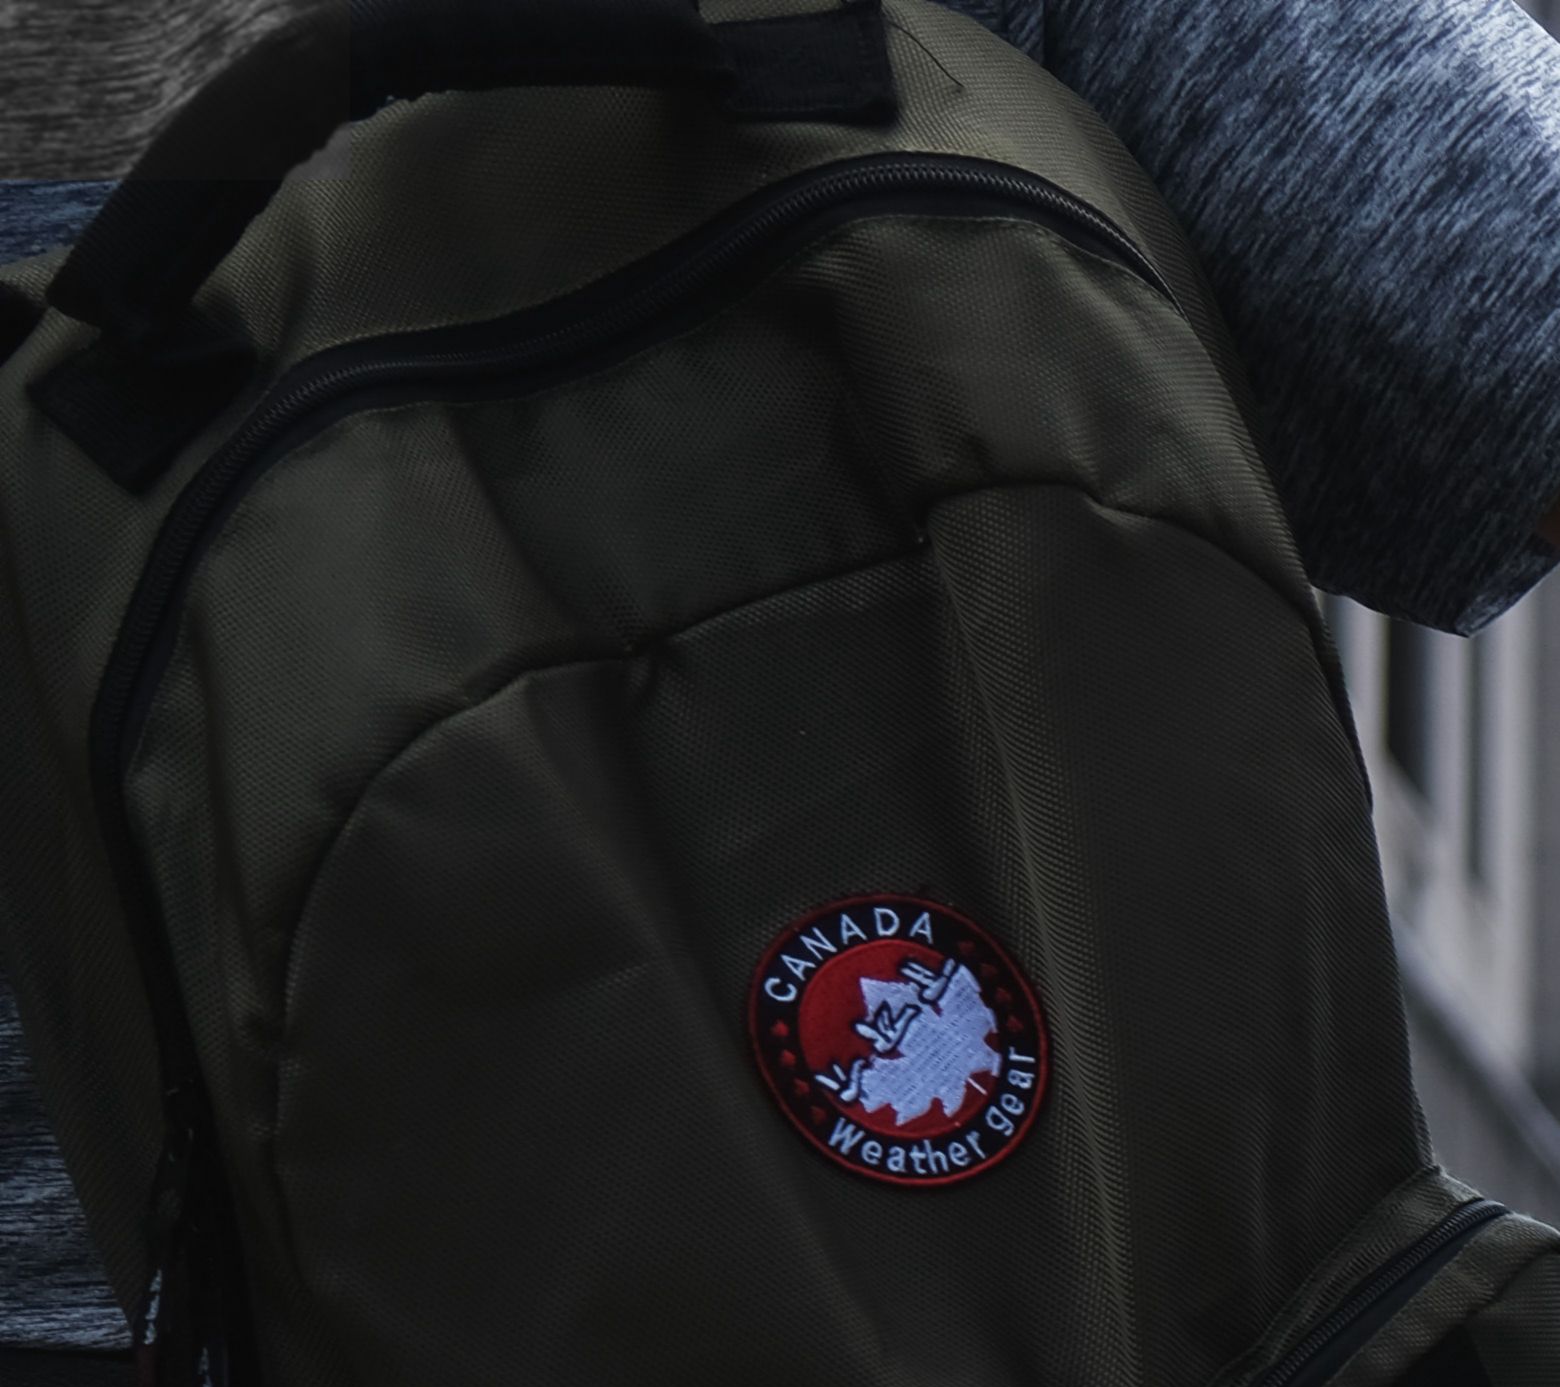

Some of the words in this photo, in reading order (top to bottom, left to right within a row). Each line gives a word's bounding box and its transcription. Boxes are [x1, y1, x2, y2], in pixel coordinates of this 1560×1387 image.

[764, 907, 934, 1003] CANADA
[828, 1117, 987, 1174] Weather
[985, 1046, 1036, 1136] gear
